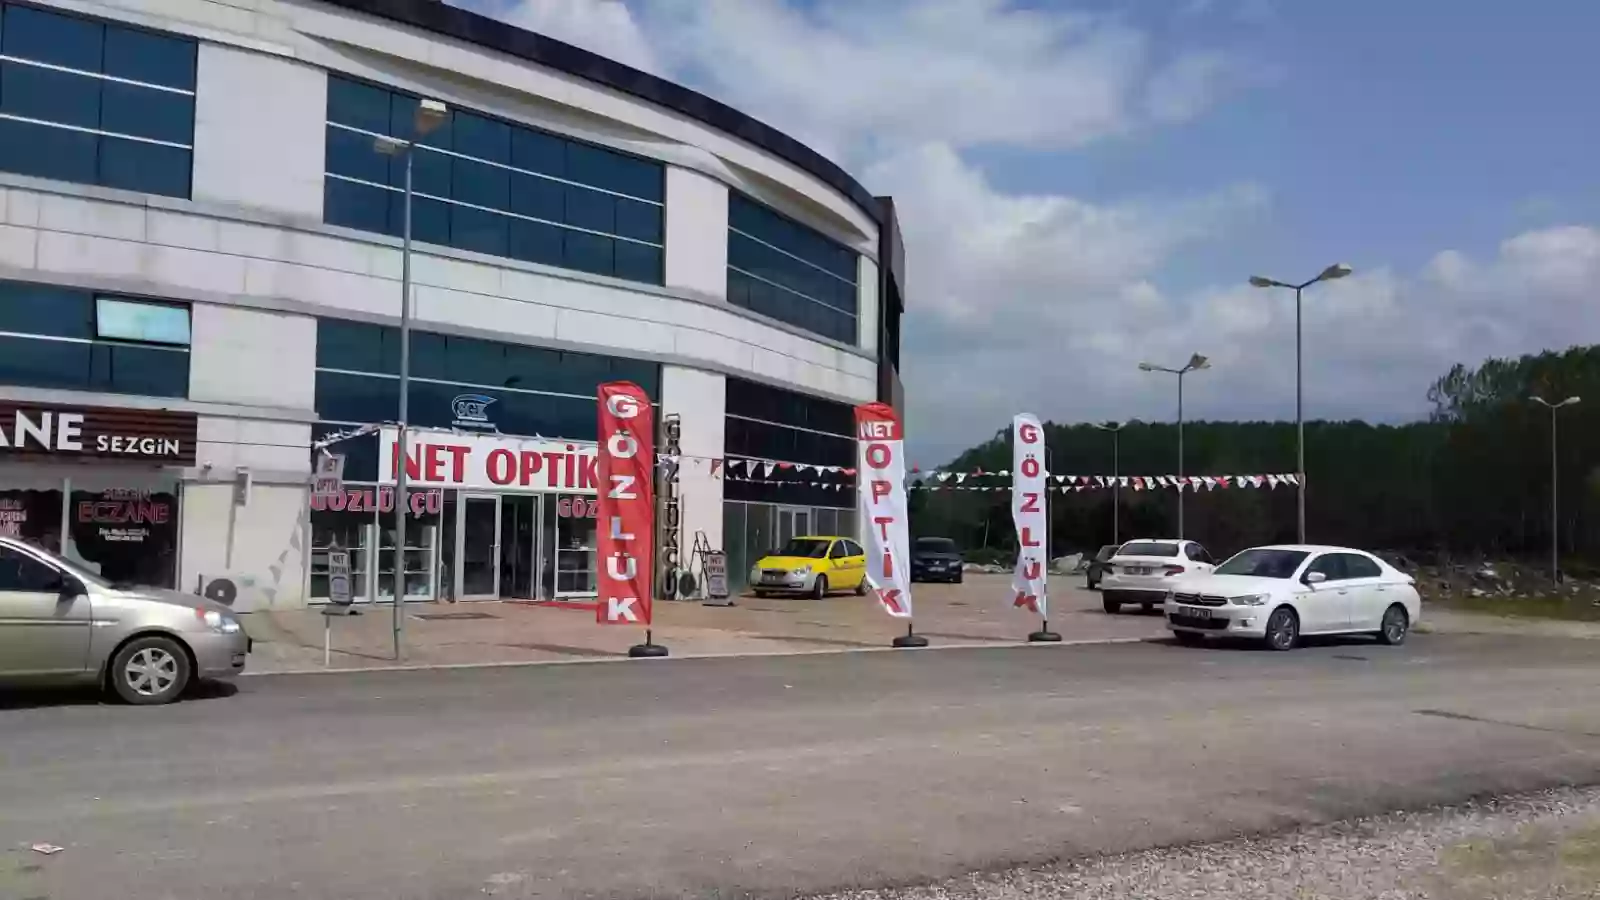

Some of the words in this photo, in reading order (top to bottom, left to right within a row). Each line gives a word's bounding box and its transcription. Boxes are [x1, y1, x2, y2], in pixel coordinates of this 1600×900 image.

[0, 409, 84, 451] NE
[860, 421, 895, 438] NET
[391, 441, 472, 483] NET
[79, 500, 170, 524] ECZANE
[606, 394, 639, 622] GÖZLÜK
[864, 443, 903, 613] OPTİK
[1013, 424, 1041, 613] GÖZLÜK
